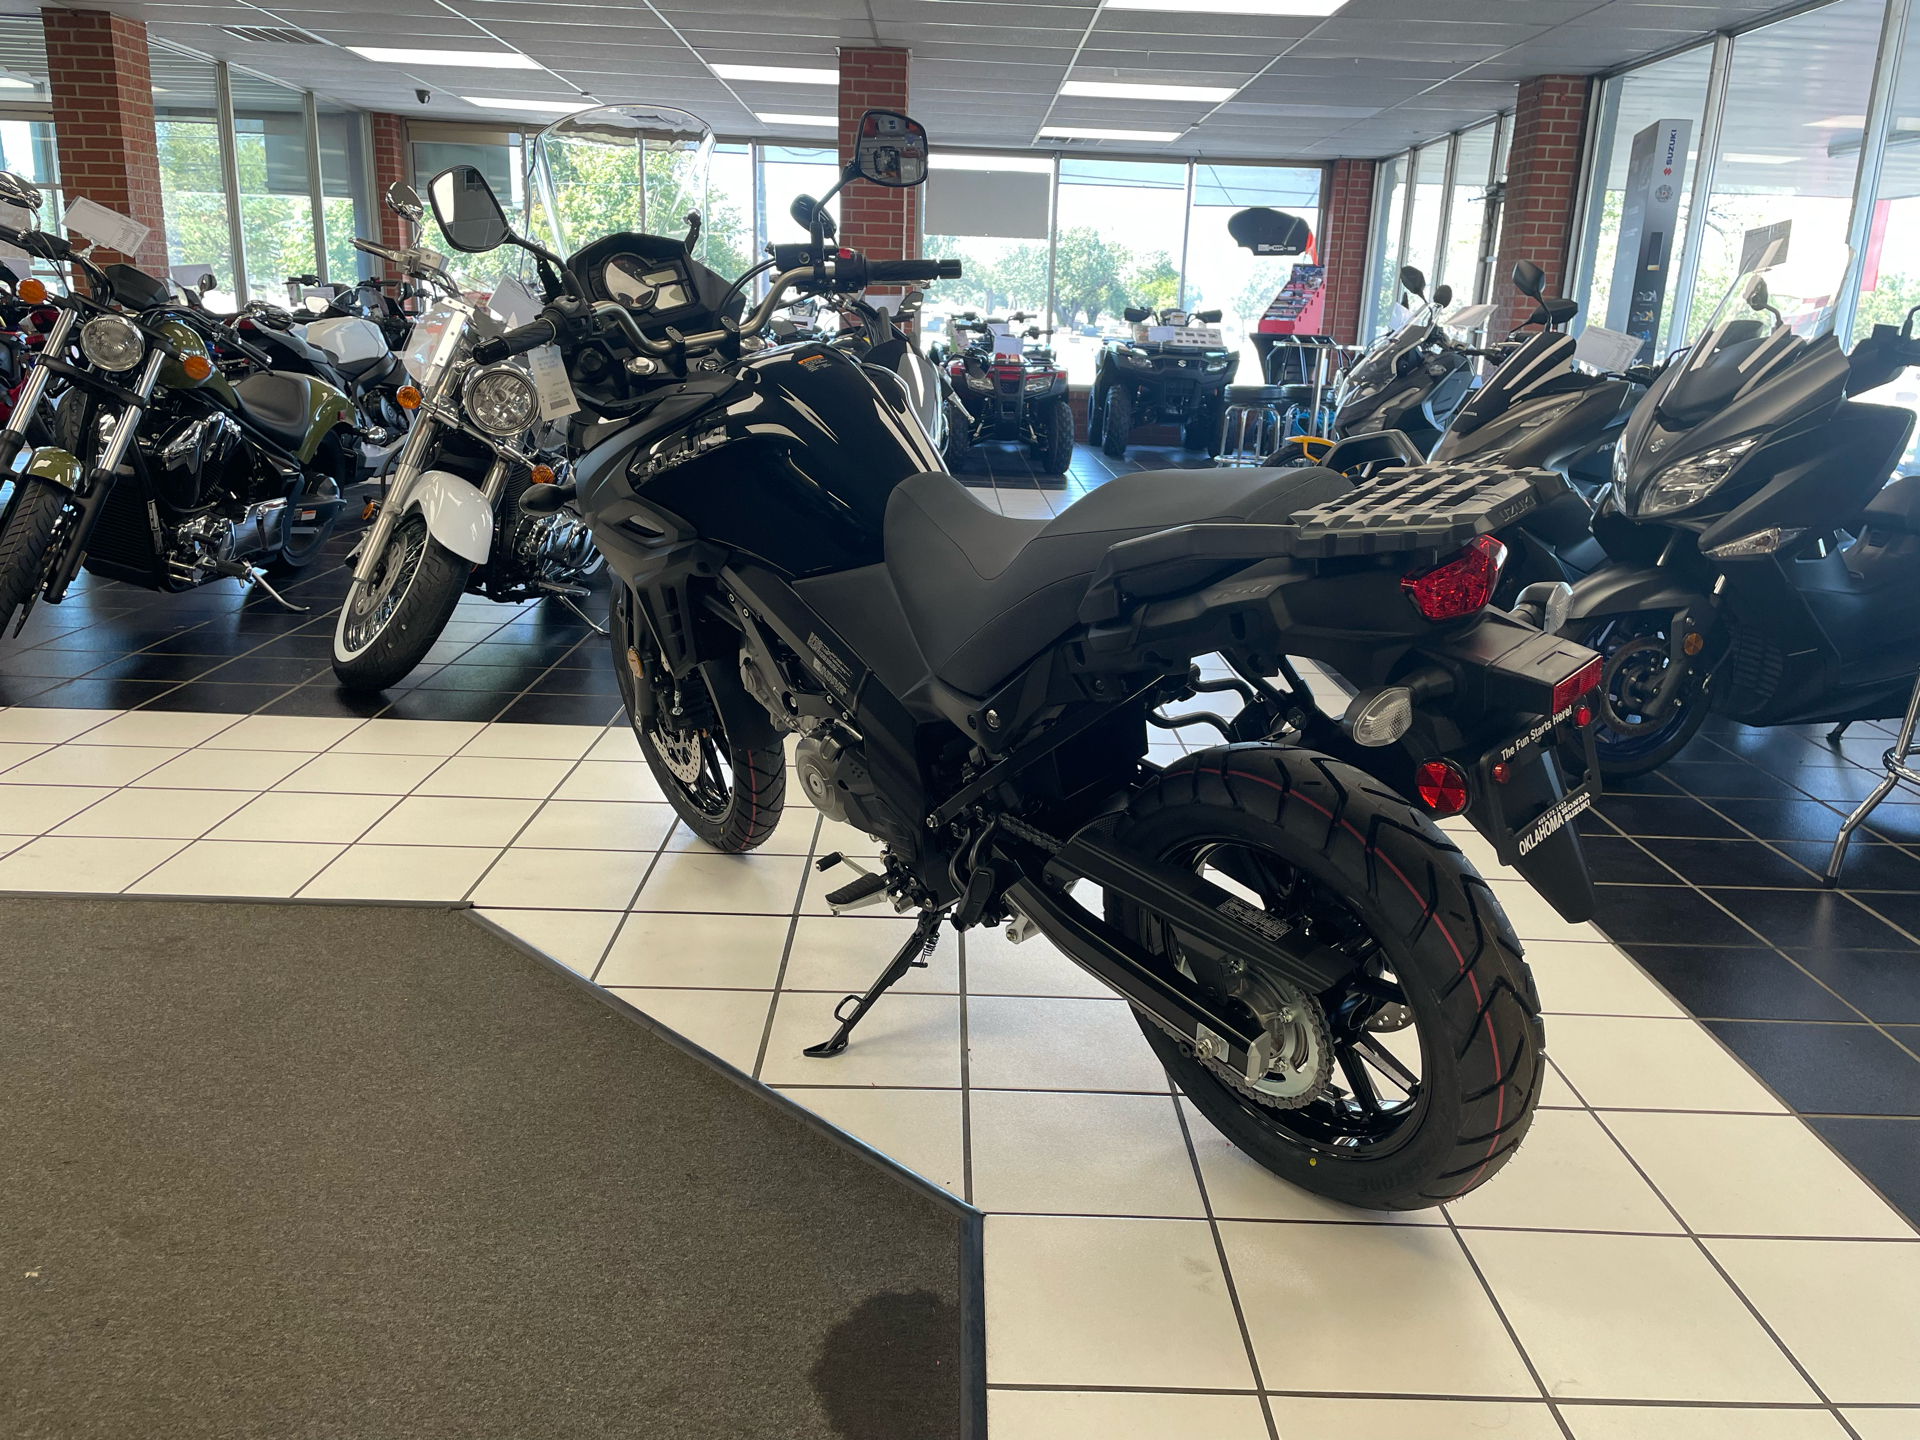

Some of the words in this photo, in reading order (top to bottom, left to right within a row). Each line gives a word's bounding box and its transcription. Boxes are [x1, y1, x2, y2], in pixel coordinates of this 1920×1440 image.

[1665, 129, 1677, 165] SUZUKI
[638, 424, 728, 485] SUZUKI
[1501, 745, 1515, 760] The
[1515, 735, 1530, 751] Fun
[1530, 720, 1552, 740] Starts
[1552, 705, 1572, 725] Here!
[1519, 812, 1565, 856] OKLAHOMA
[1561, 791, 1591, 816] HONDA
[1564, 799, 1591, 822] SUZUKI
